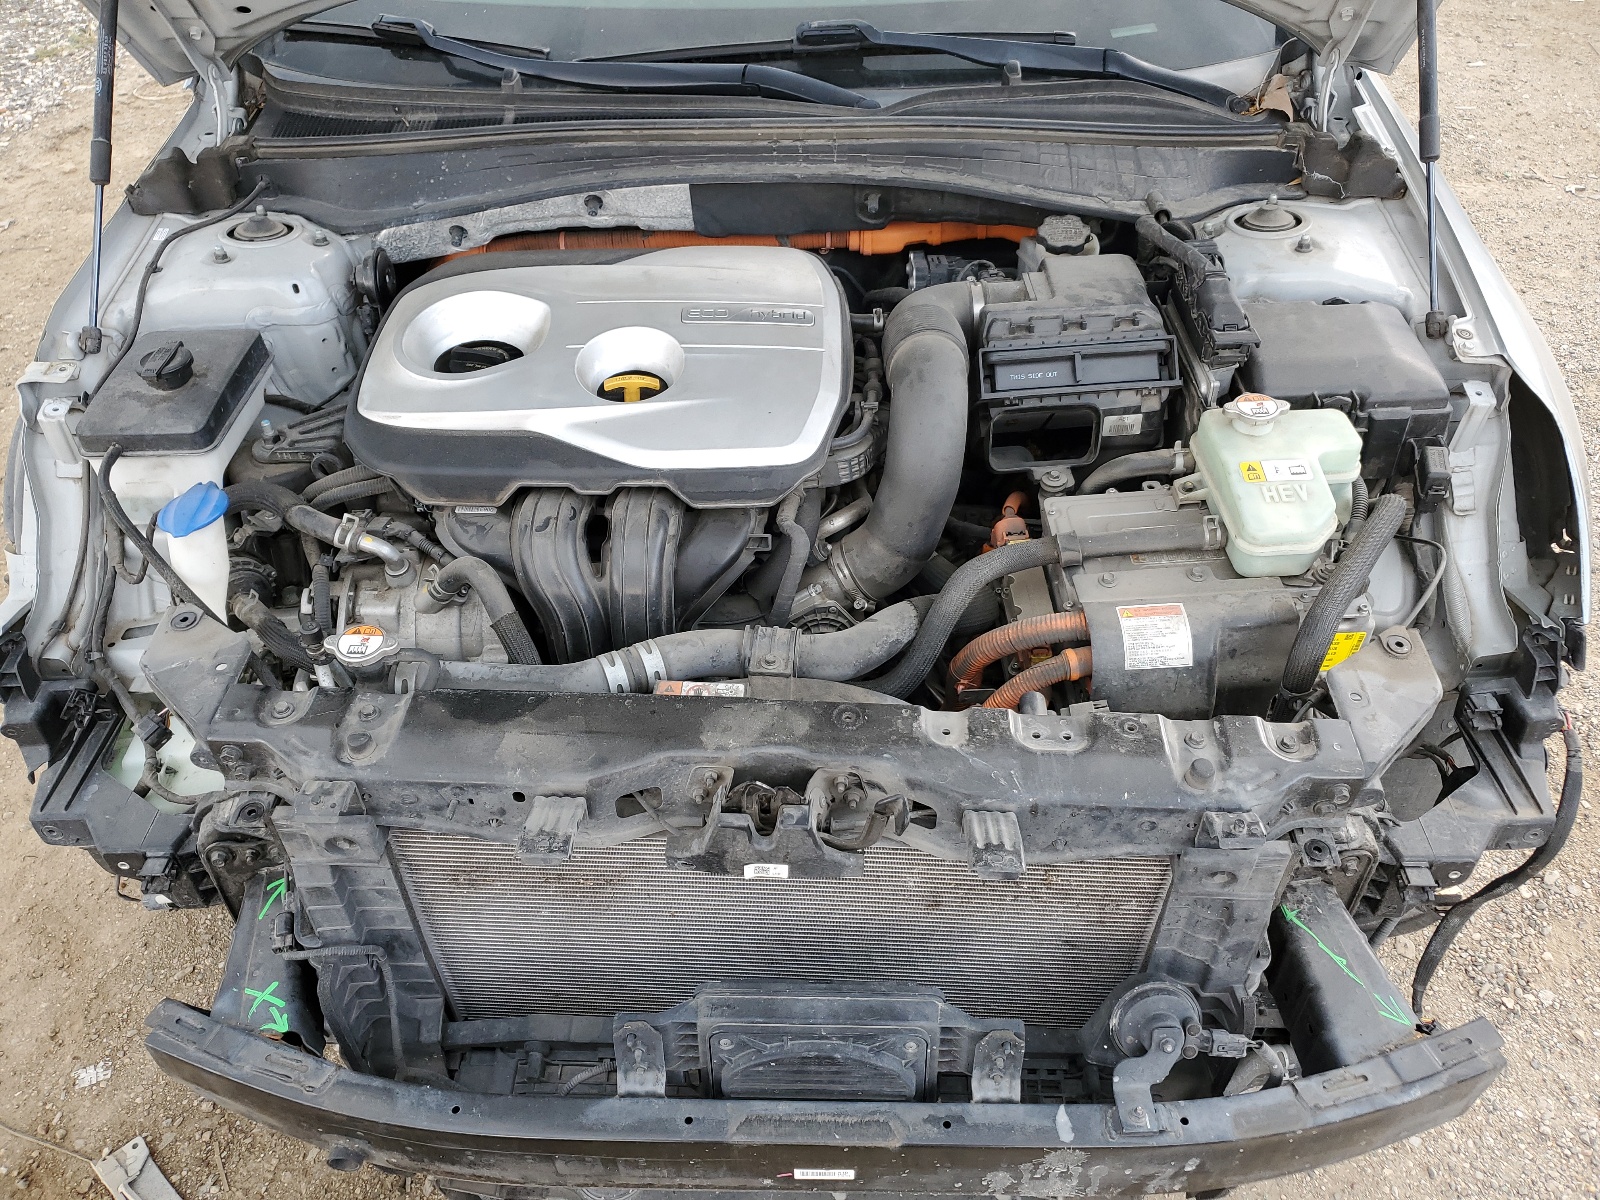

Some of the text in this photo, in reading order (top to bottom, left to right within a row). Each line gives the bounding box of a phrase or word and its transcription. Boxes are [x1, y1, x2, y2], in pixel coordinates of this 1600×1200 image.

[687, 308, 806, 321] ECO hybrid
[1259, 484, 1309, 503] HEV
